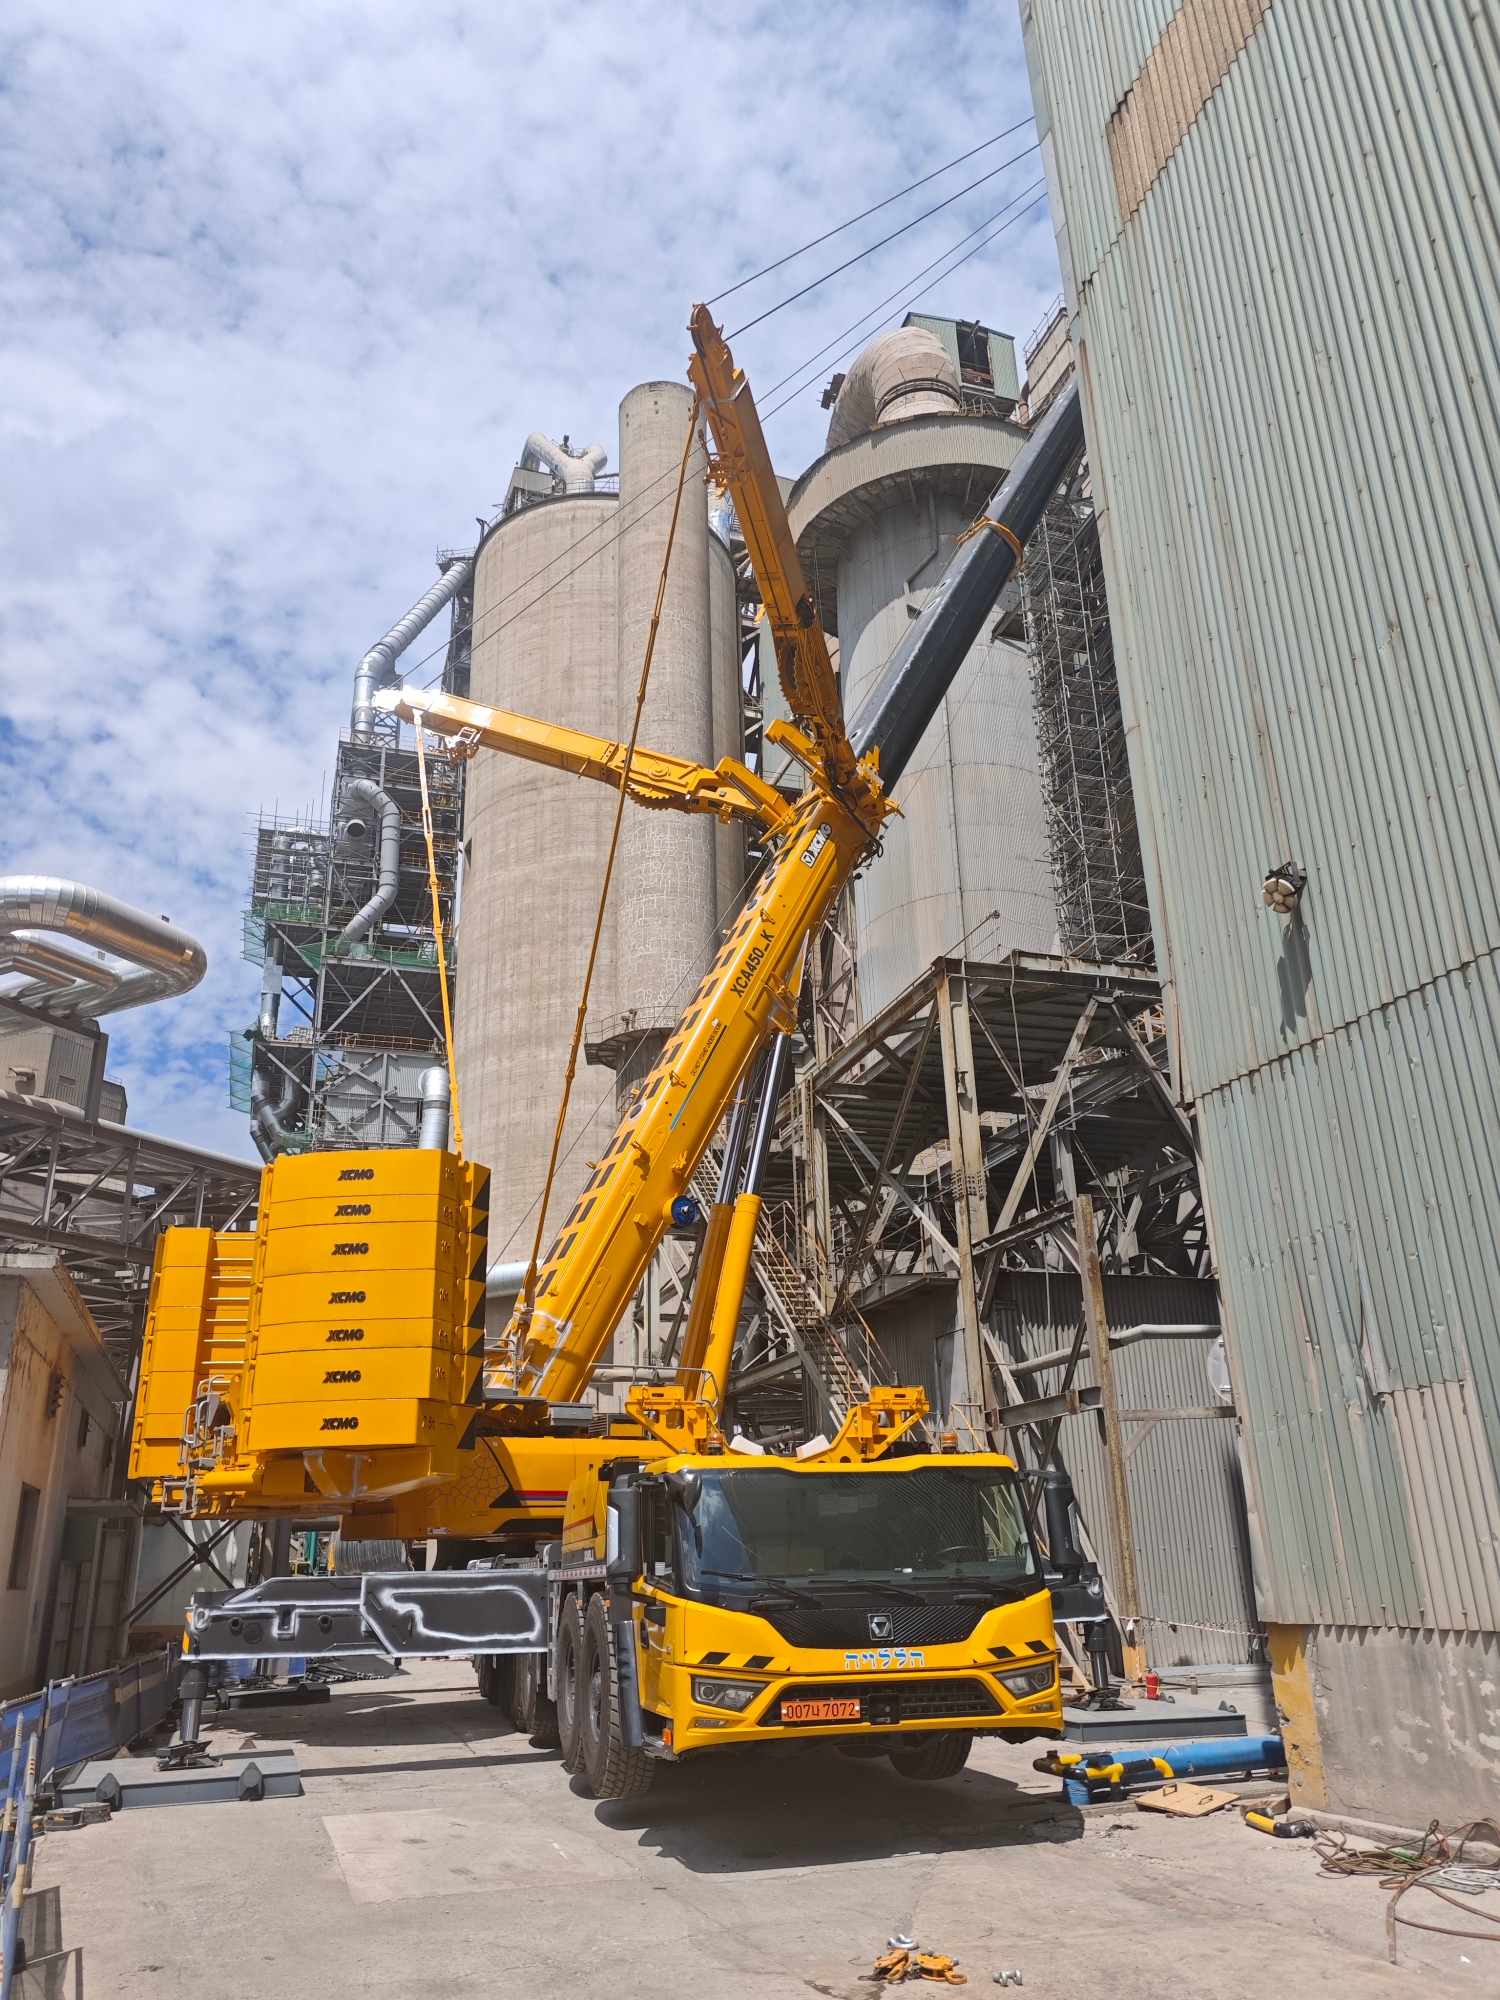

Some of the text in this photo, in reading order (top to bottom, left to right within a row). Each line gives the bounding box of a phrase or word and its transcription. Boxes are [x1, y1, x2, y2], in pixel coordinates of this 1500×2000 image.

[809, 822, 832, 857] XCMG
[698, 1047, 709, 1061] STAND
[705, 1034, 716, 1048] UNDER
[337, 1169, 374, 1181] XCMG
[334, 1204, 371, 1216] XCMG
[331, 1243, 369, 1255] XCMG
[328, 1291, 366, 1304] XCMG
[326, 1329, 364, 1342] XCMG
[322, 1370, 361, 1384] XCMG
[319, 1417, 359, 1430] XCMG
[845, 1648, 925, 1670] הללויה
[822, 1702, 856, 1717] 7072
